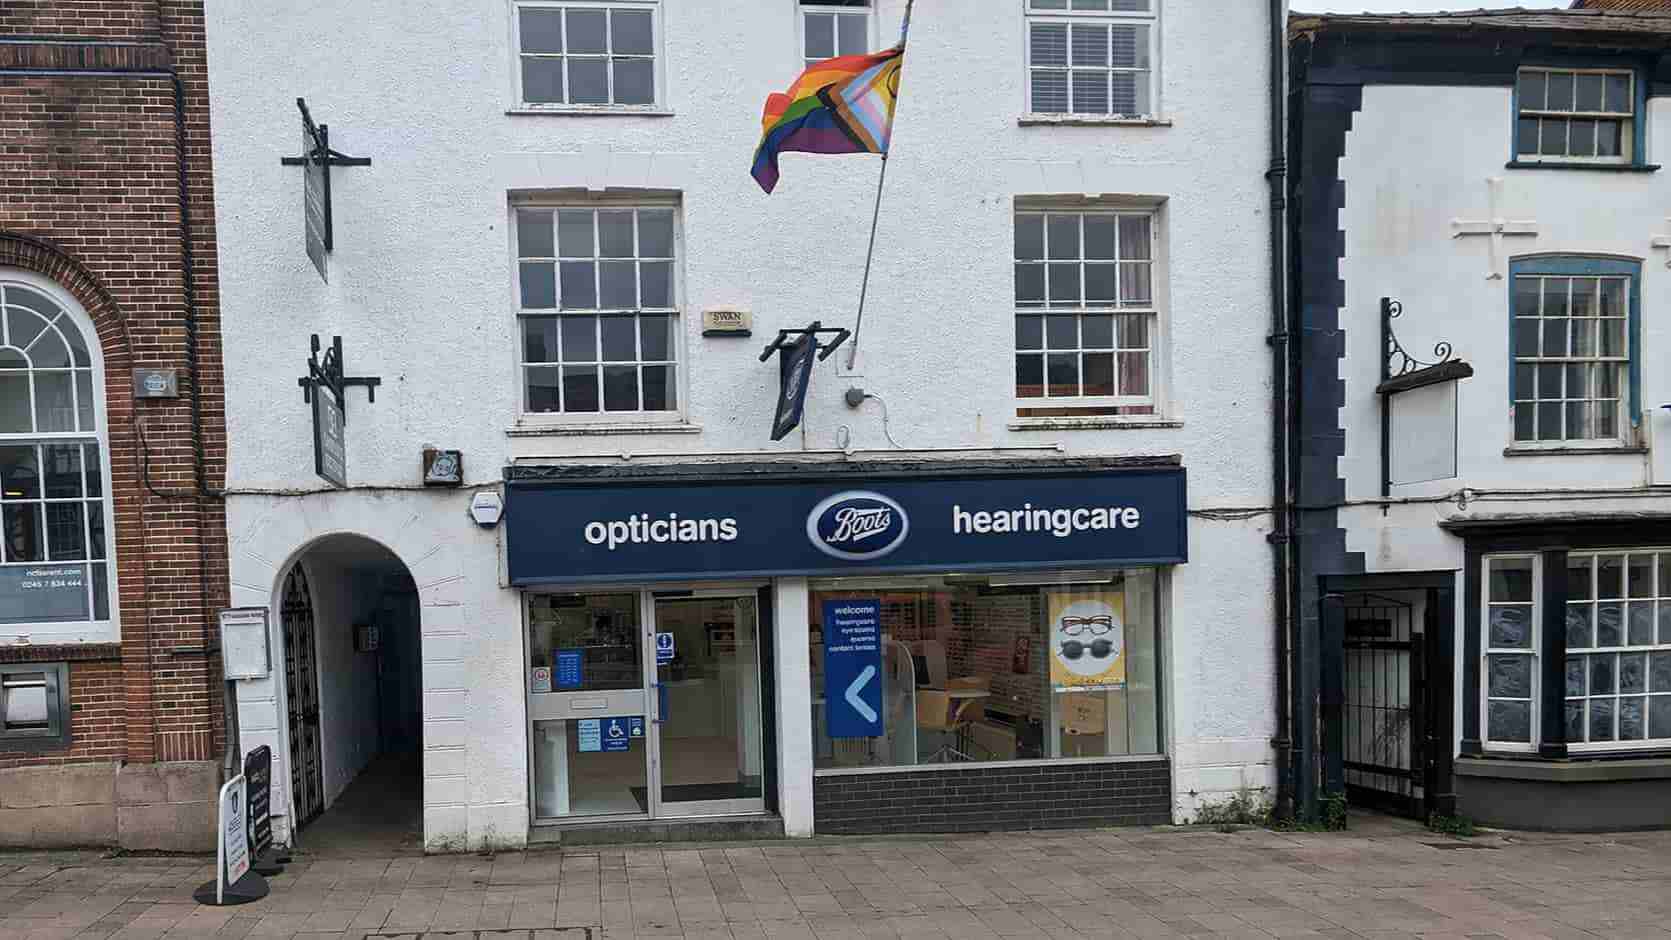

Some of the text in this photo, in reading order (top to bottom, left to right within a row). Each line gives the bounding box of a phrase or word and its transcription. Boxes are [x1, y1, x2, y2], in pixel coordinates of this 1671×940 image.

[712, 311, 744, 321] SWAN
[584, 513, 738, 550] opticians
[825, 507, 891, 543] Boots
[953, 503, 1140, 537] hearingcare
[835, 606, 875, 614] welcome
